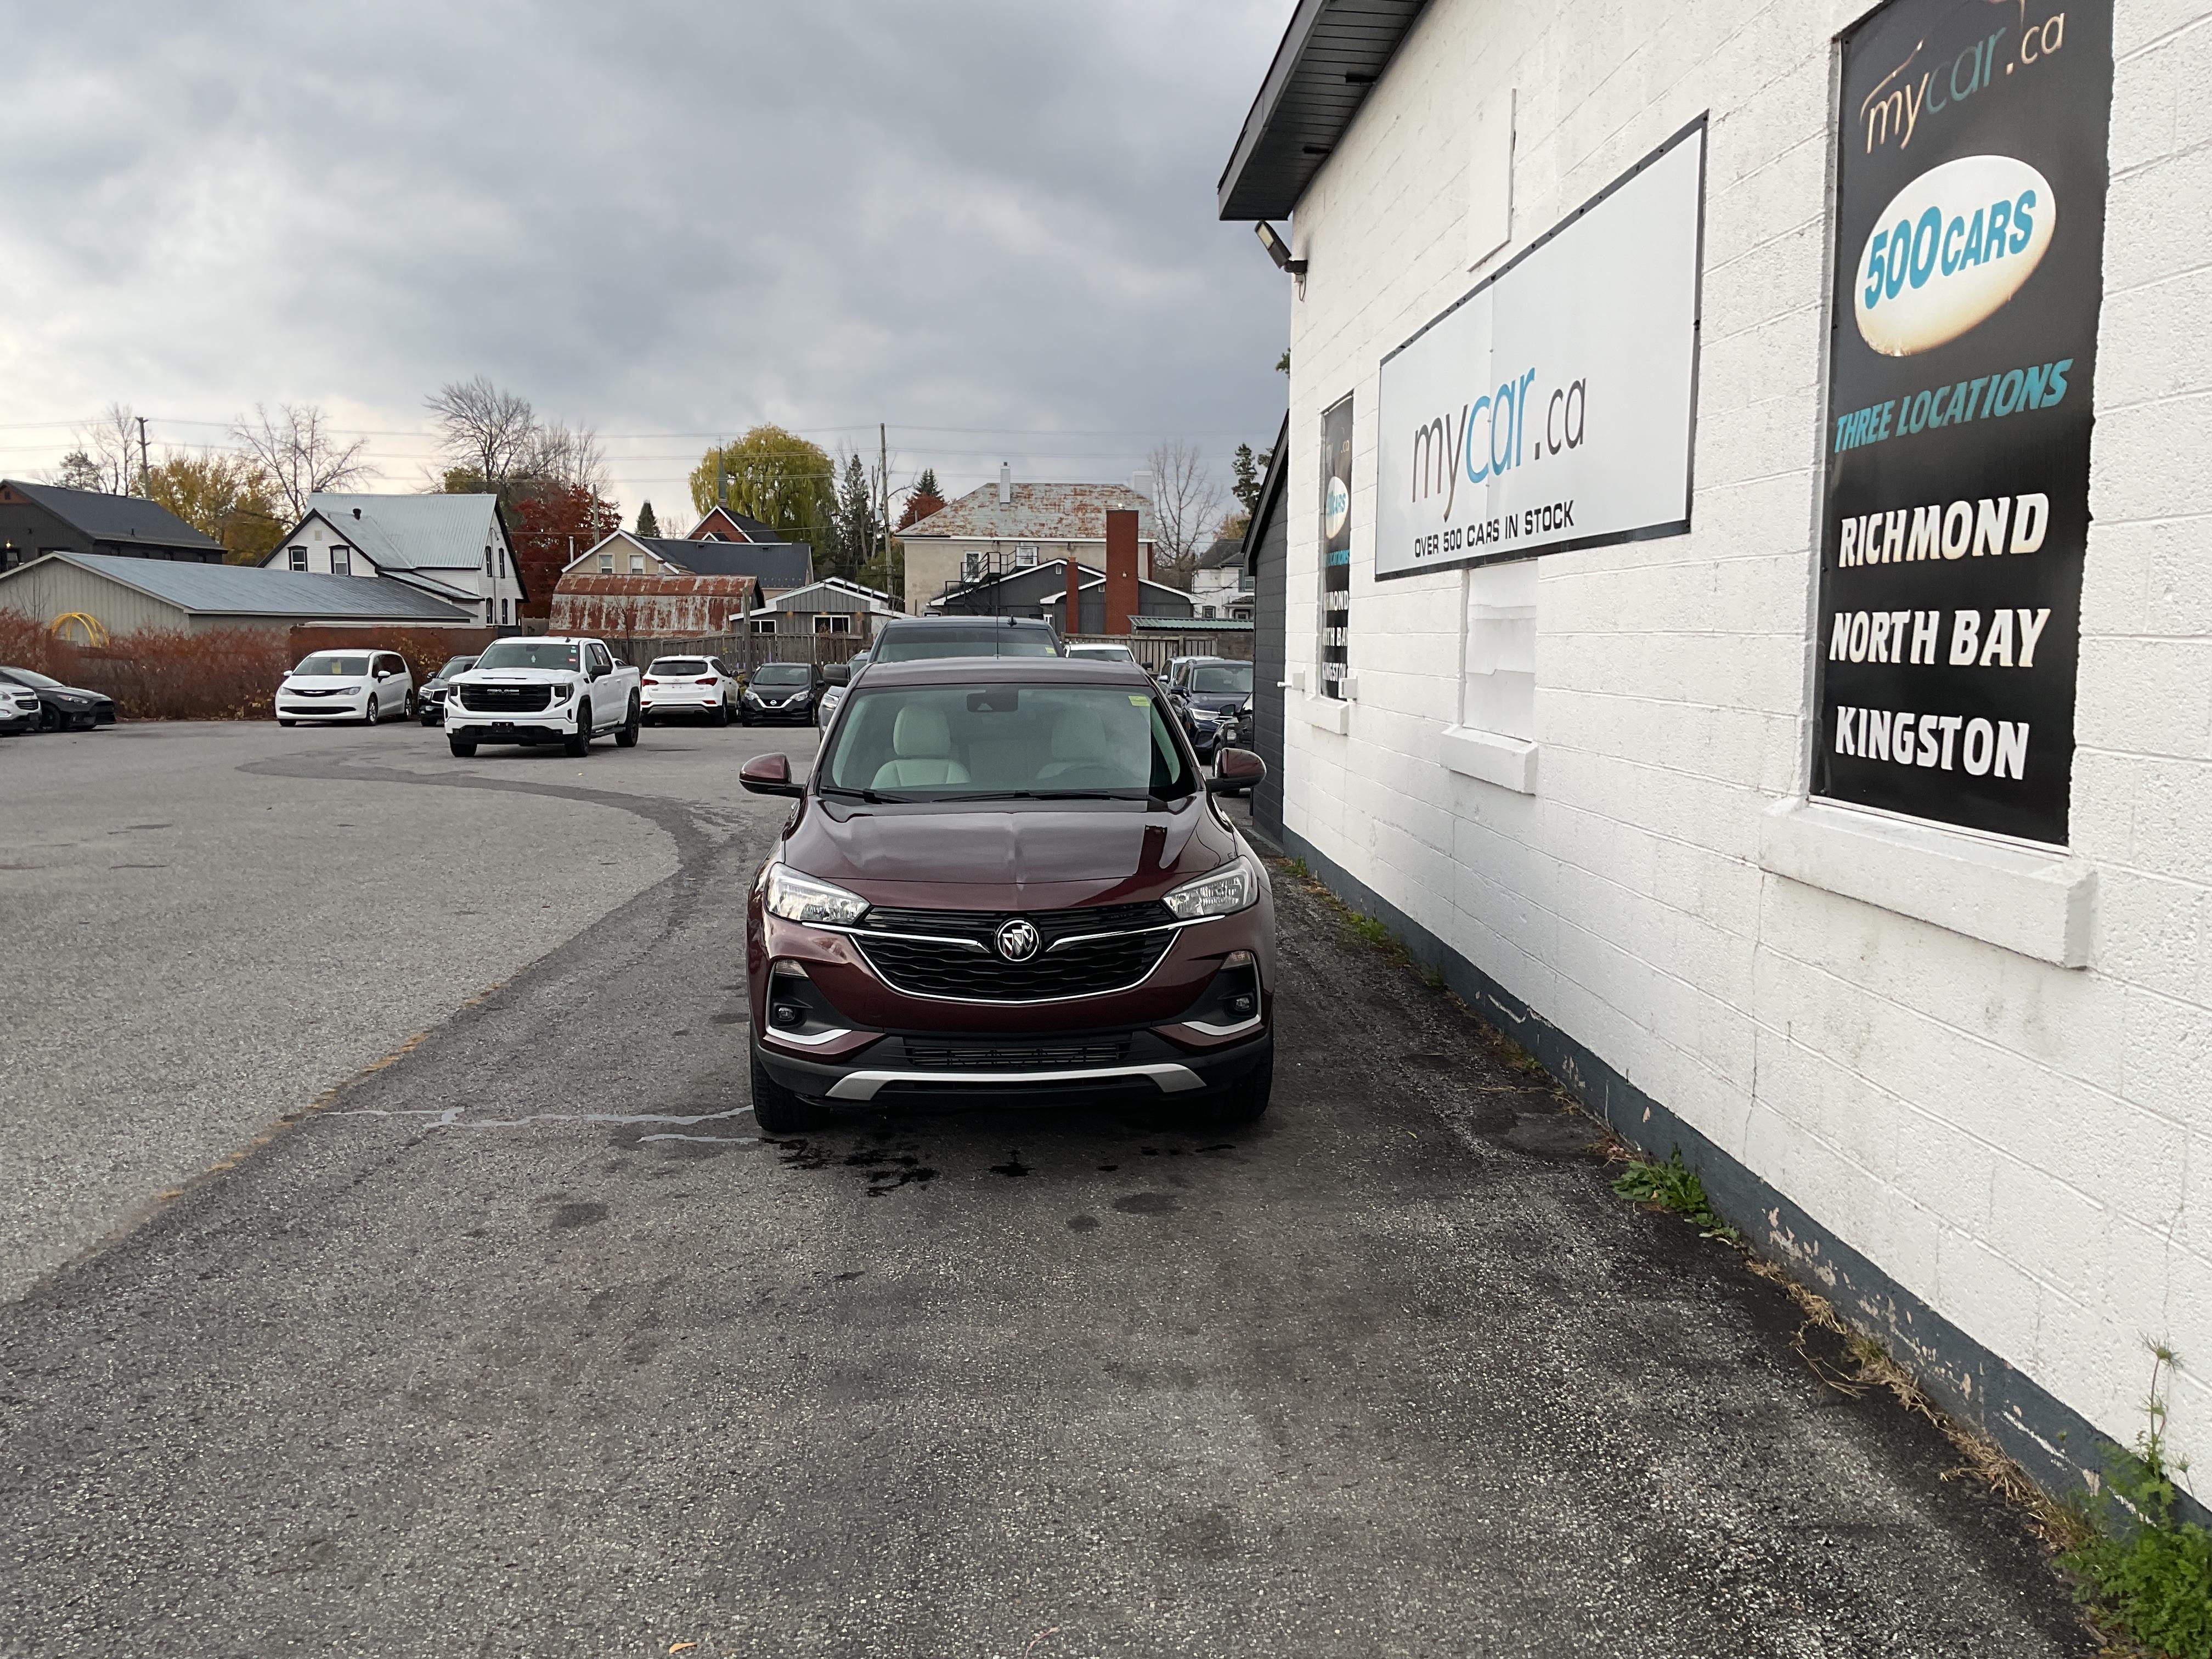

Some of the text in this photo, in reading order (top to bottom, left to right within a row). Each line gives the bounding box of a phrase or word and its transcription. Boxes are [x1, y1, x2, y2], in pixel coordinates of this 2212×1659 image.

[1866, 12, 2065, 154] mycar.ca
[1835, 359, 2074, 452] THREE LOCATIONS
[1413, 368, 1587, 522] mycar.ca
[1414, 500, 1575, 558] OVER 500 CARS IN STOCK
[1838, 493, 2050, 568] RICHMOND
[1829, 608, 2051, 667] NORTH BAY
[1835, 706, 2030, 781] KINGSTON
